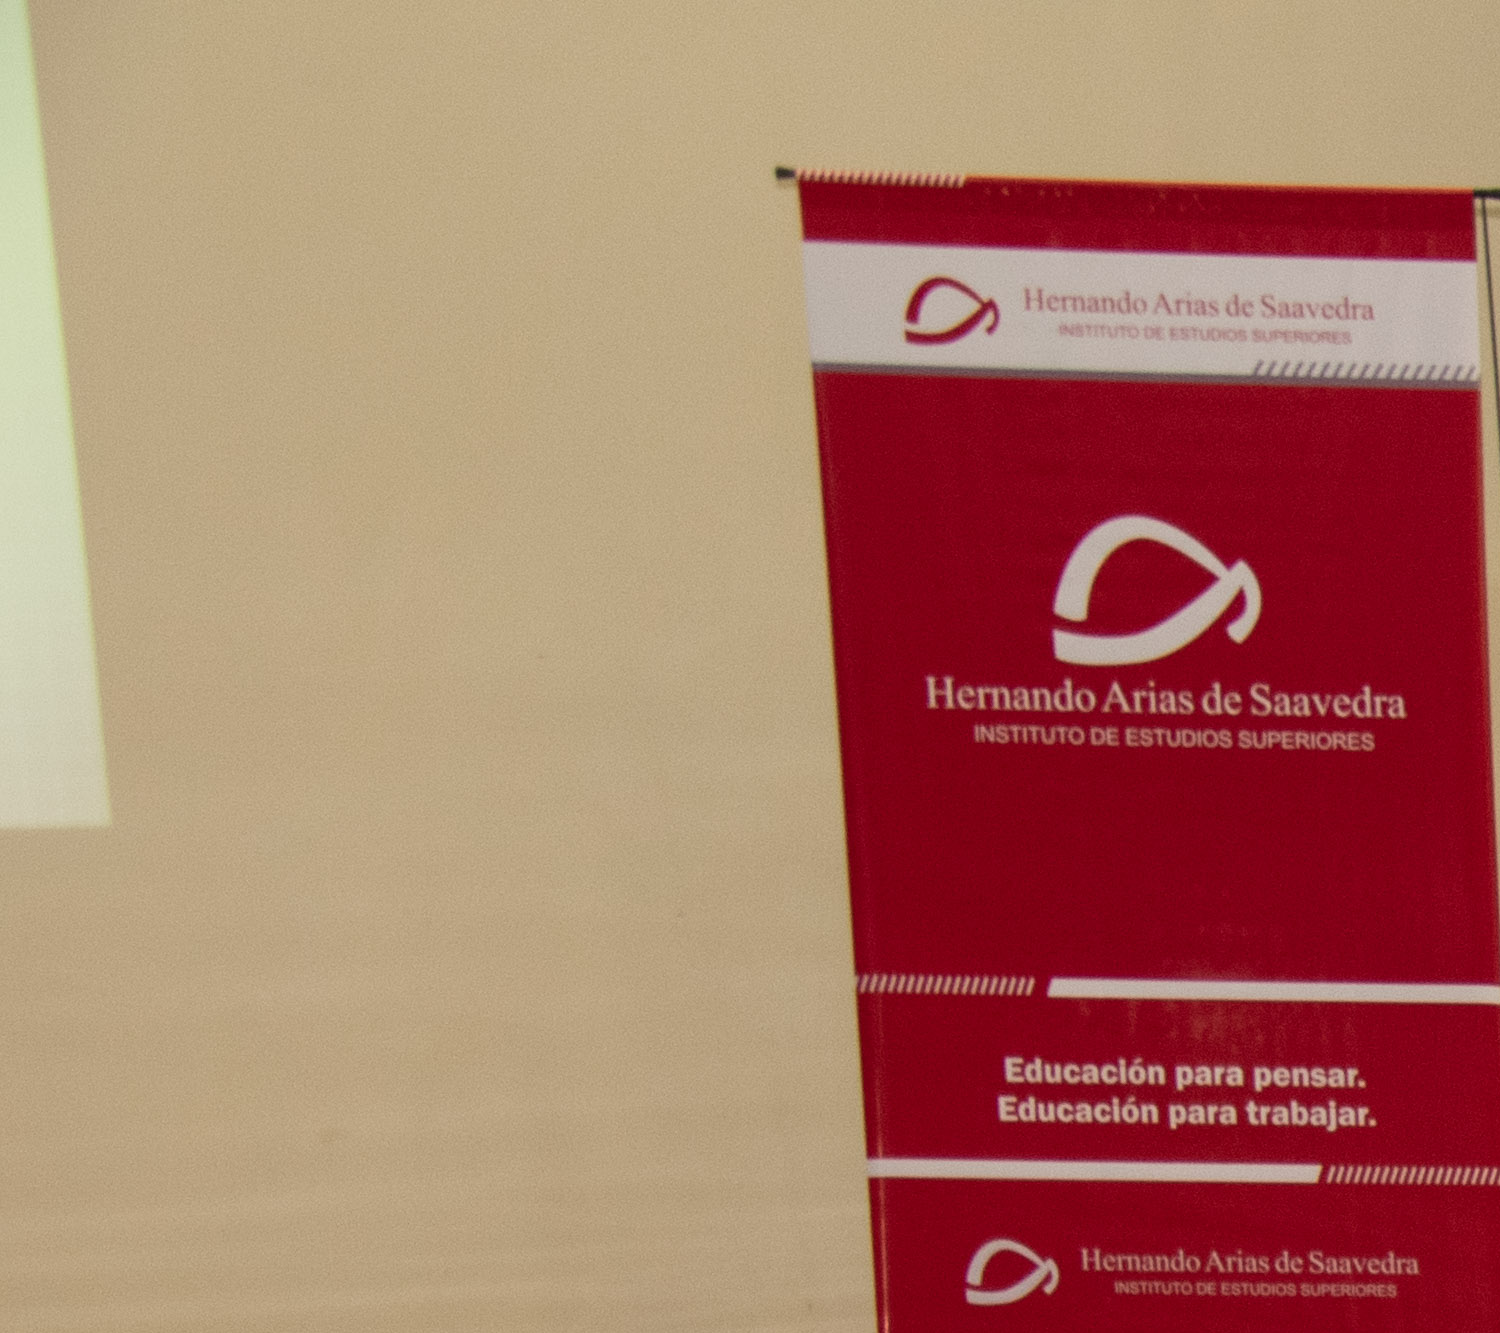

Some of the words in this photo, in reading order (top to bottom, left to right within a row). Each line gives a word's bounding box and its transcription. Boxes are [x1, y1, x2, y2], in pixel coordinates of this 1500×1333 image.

[1023, 287, 1149, 315] Hernando
[1152, 292, 1220, 318] Arias
[1225, 293, 1255, 319] de
[1259, 294, 1375, 321] Saavedra
[1057, 322, 1141, 340] INSTITUTO
[1142, 325, 1165, 341] DE
[1168, 325, 1249, 343] ESTUDIOS
[1250, 327, 1353, 346] SUPERIORES
[926, 675, 1097, 713] Hernando
[1101, 680, 1196, 715] Arias
[1201, 681, 1242, 716] de
[1249, 682, 1407, 719] Saavedra
[973, 723, 1086, 746] INSTITUTO
[1089, 726, 1120, 747] DE
[1124, 726, 1234, 749] ESTUDIOS
[1237, 729, 1376, 752] SUPERIORES
[1004, 1056, 1167, 1086] Educación
[1175, 1064, 1245, 1092] para
[1253, 1066, 1367, 1093] pensar.
[997, 1094, 1160, 1124] Educación
[1168, 1103, 1238, 1130] para
[1244, 1099, 1377, 1133] trabajar.
[1080, 1247, 1202, 1273] Hernando
[1204, 1249, 1272, 1274] Arias
[1273, 1249, 1304, 1275] de
[1307, 1250, 1420, 1276] Saavedra
[1113, 1279, 1195, 1296] INSTITUTO
[1194, 1281, 1217, 1296] DE
[1219, 1280, 1298, 1297] ESTUDIOS
[1299, 1282, 1398, 1299] SUPERIORES
